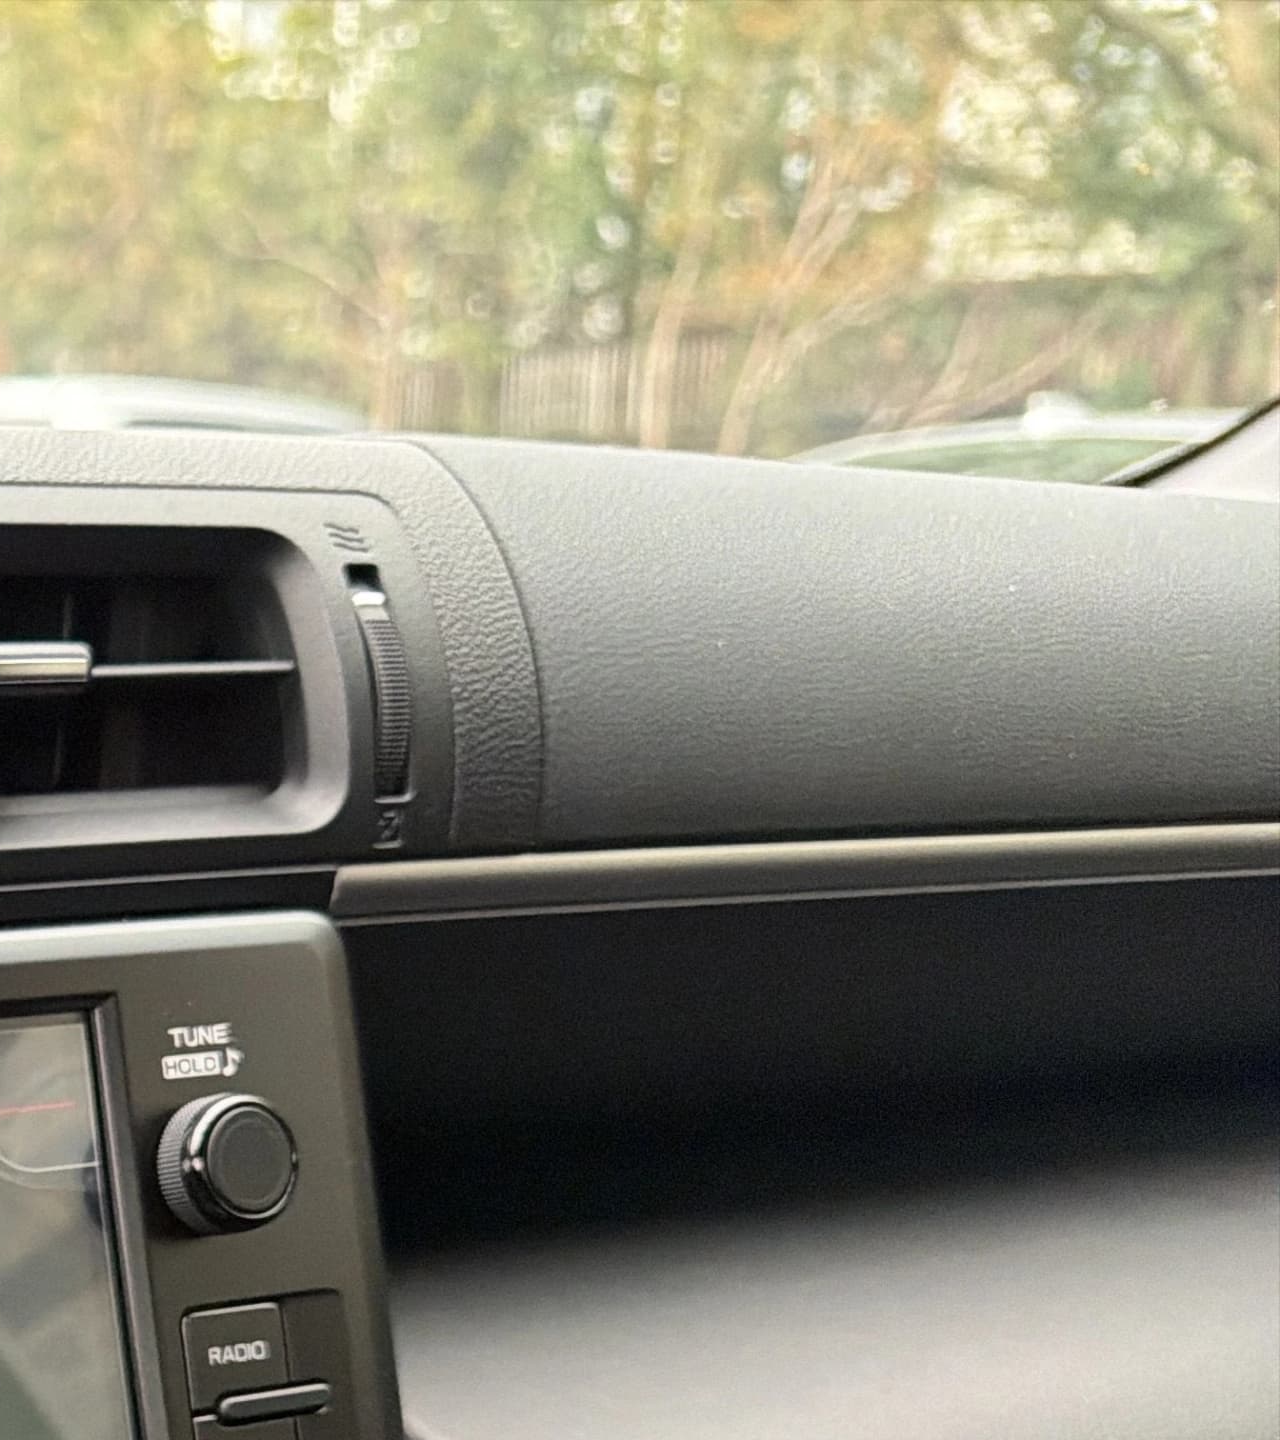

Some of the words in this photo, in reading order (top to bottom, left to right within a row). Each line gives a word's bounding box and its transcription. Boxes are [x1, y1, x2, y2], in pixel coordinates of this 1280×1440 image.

[167, 1022, 231, 1048] TUNE
[163, 1054, 218, 1077] HOLD
[207, 1340, 269, 1366] RADIO
